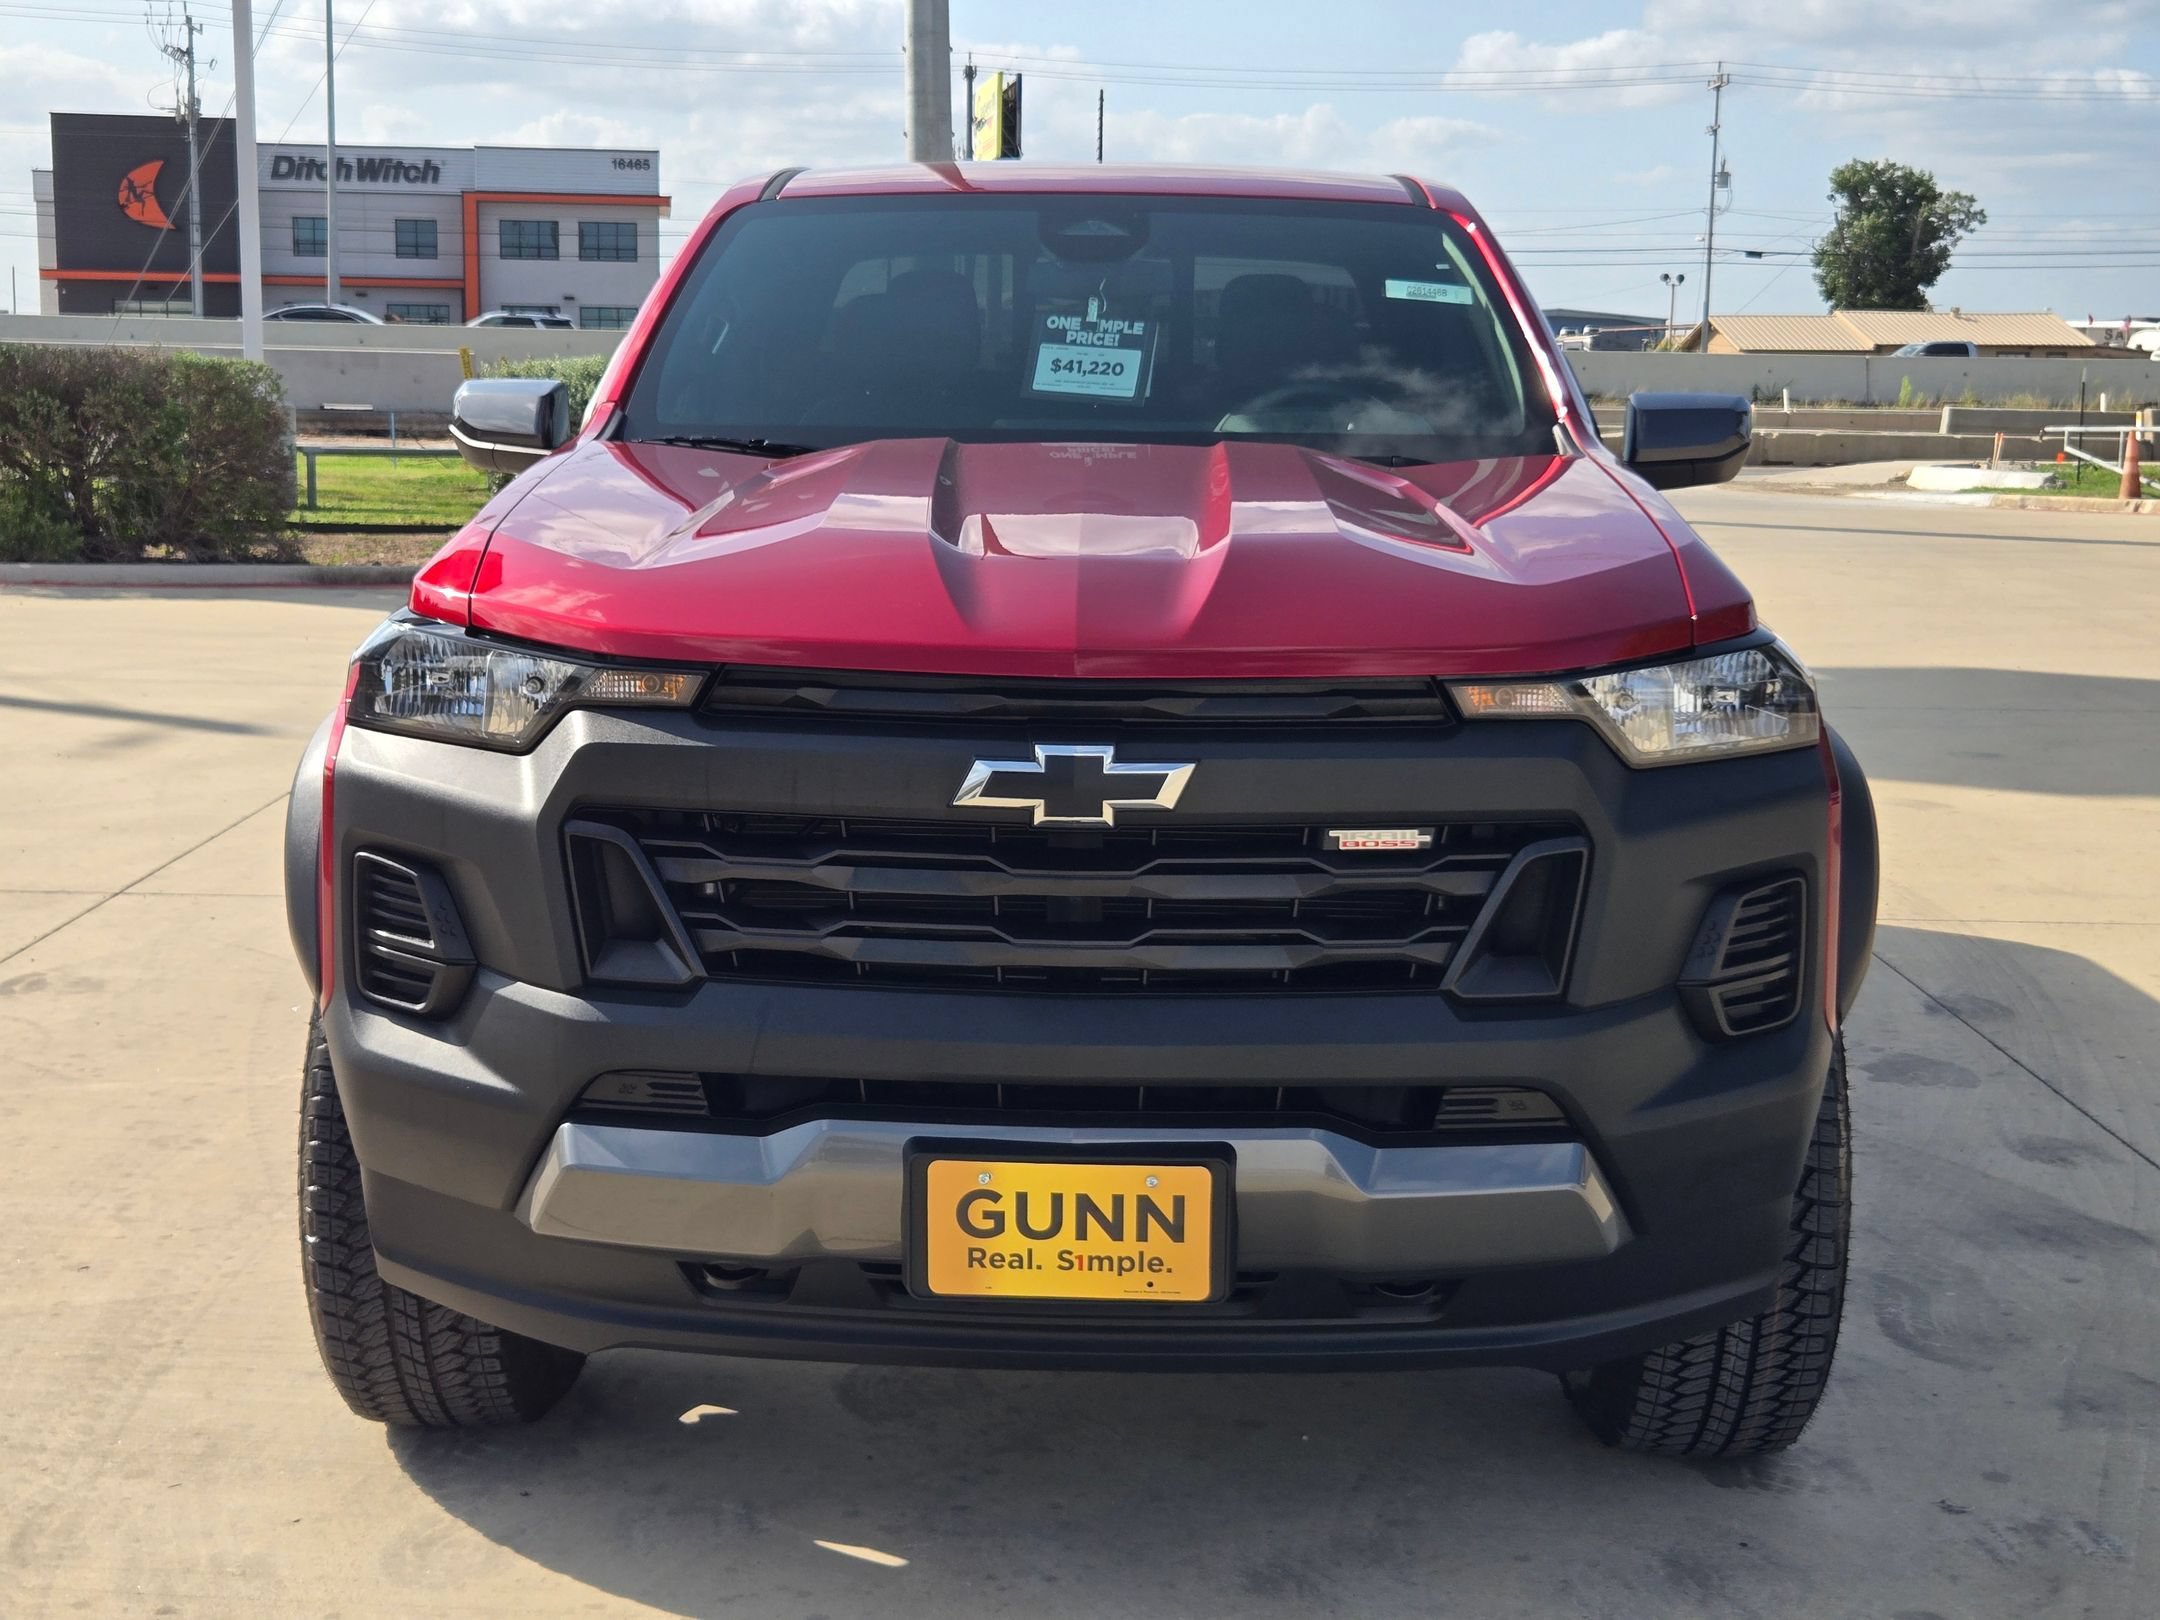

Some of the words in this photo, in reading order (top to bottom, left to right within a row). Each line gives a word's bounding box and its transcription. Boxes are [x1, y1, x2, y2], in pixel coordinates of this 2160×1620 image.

[270, 155, 353, 182] Ditch
[355, 157, 441, 184] Witch
[612, 158, 651, 171] 16465
[1046, 316, 1082, 331] ONE
[1065, 331, 1120, 347] PRICE!
[1050, 357, 1125, 377] $41,220
[1341, 840, 1417, 849] BOSS
[956, 1188, 1186, 1244] GUNN
[967, 1247, 1043, 1270] Real.
